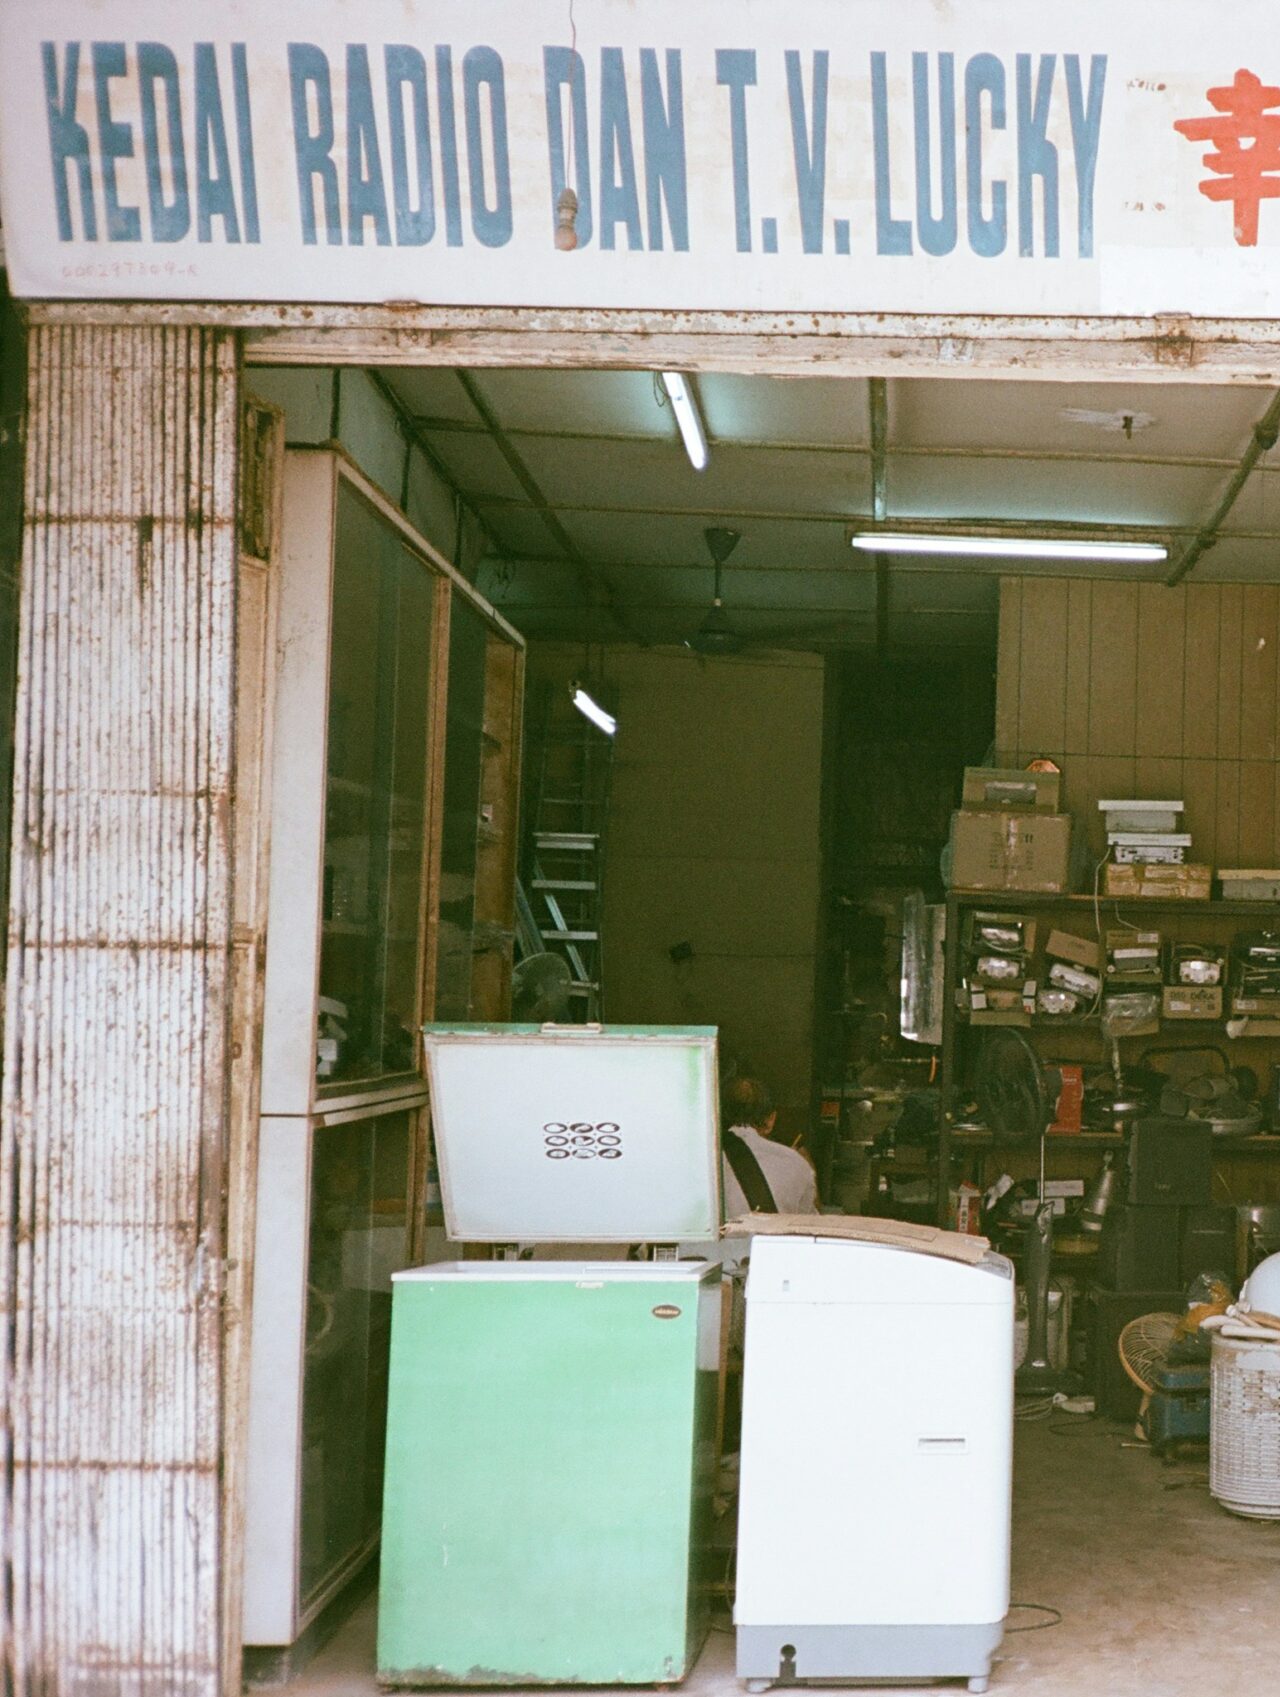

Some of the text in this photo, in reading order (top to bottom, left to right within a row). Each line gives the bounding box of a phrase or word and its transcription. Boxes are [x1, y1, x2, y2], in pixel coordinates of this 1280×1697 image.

[43, 42, 261, 242] KEDAI
[287, 43, 513, 248] RADIO
[544, 46, 689, 252] DAN
[871, 51, 1108, 259] LUCKY
